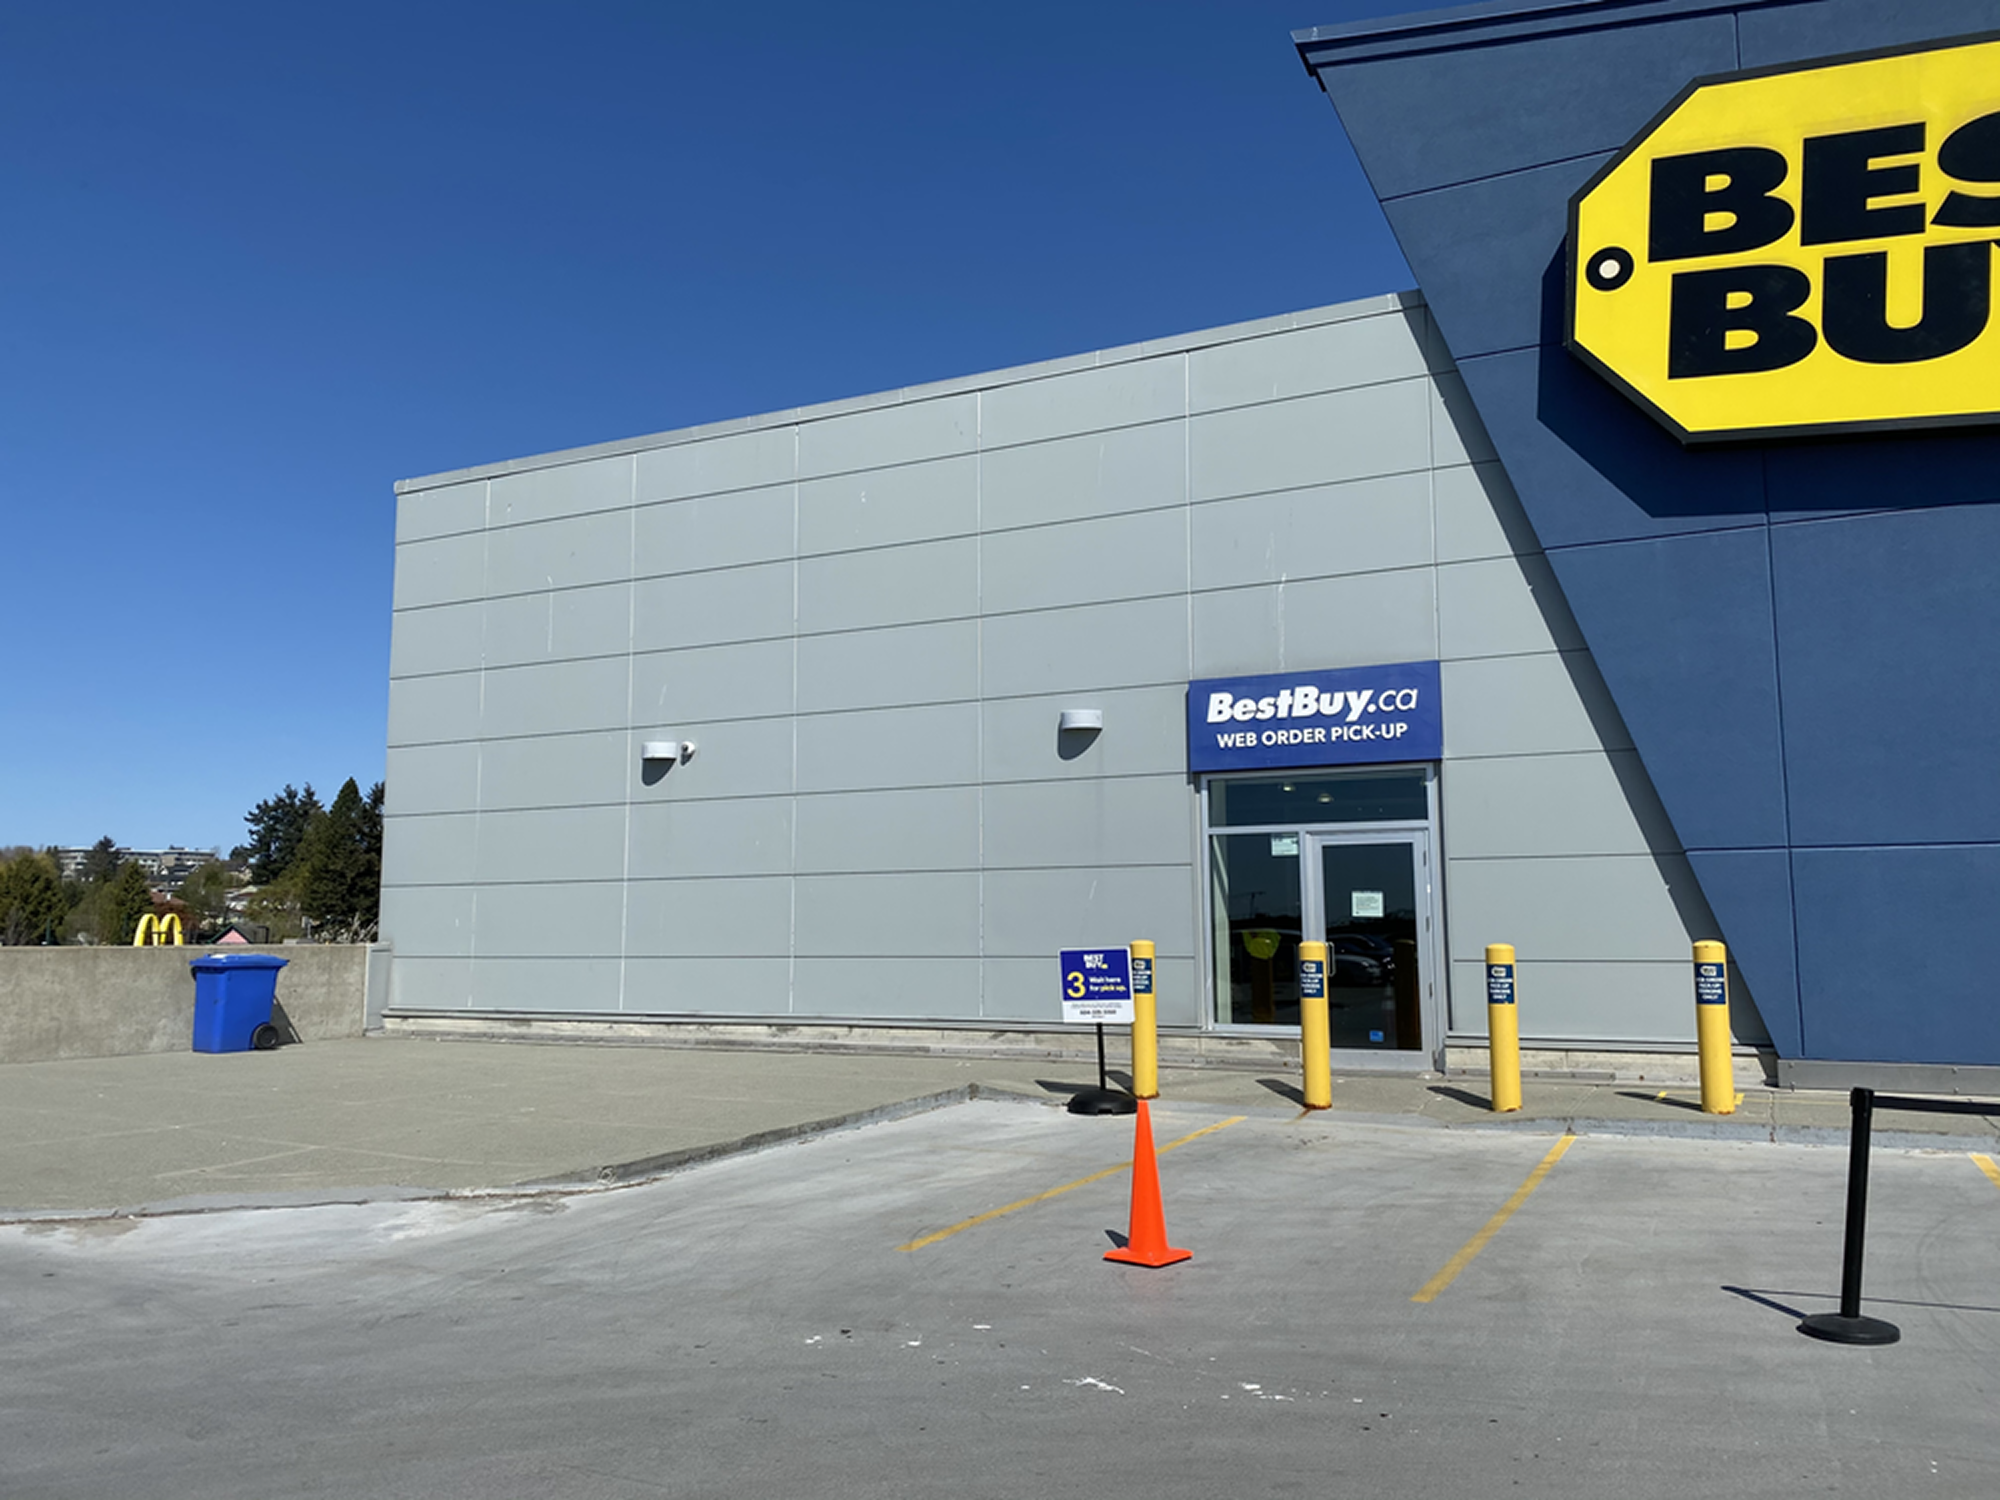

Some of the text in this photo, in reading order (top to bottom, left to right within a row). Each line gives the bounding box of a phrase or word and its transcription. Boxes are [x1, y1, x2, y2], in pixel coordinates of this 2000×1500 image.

[1668, 240, 2000, 379] BU
[1207, 686, 1418, 723] BestBuy.ca
[1217, 722, 1408, 748] WEB ORDER PICK-UP
[1067, 971, 1086, 998] 3
